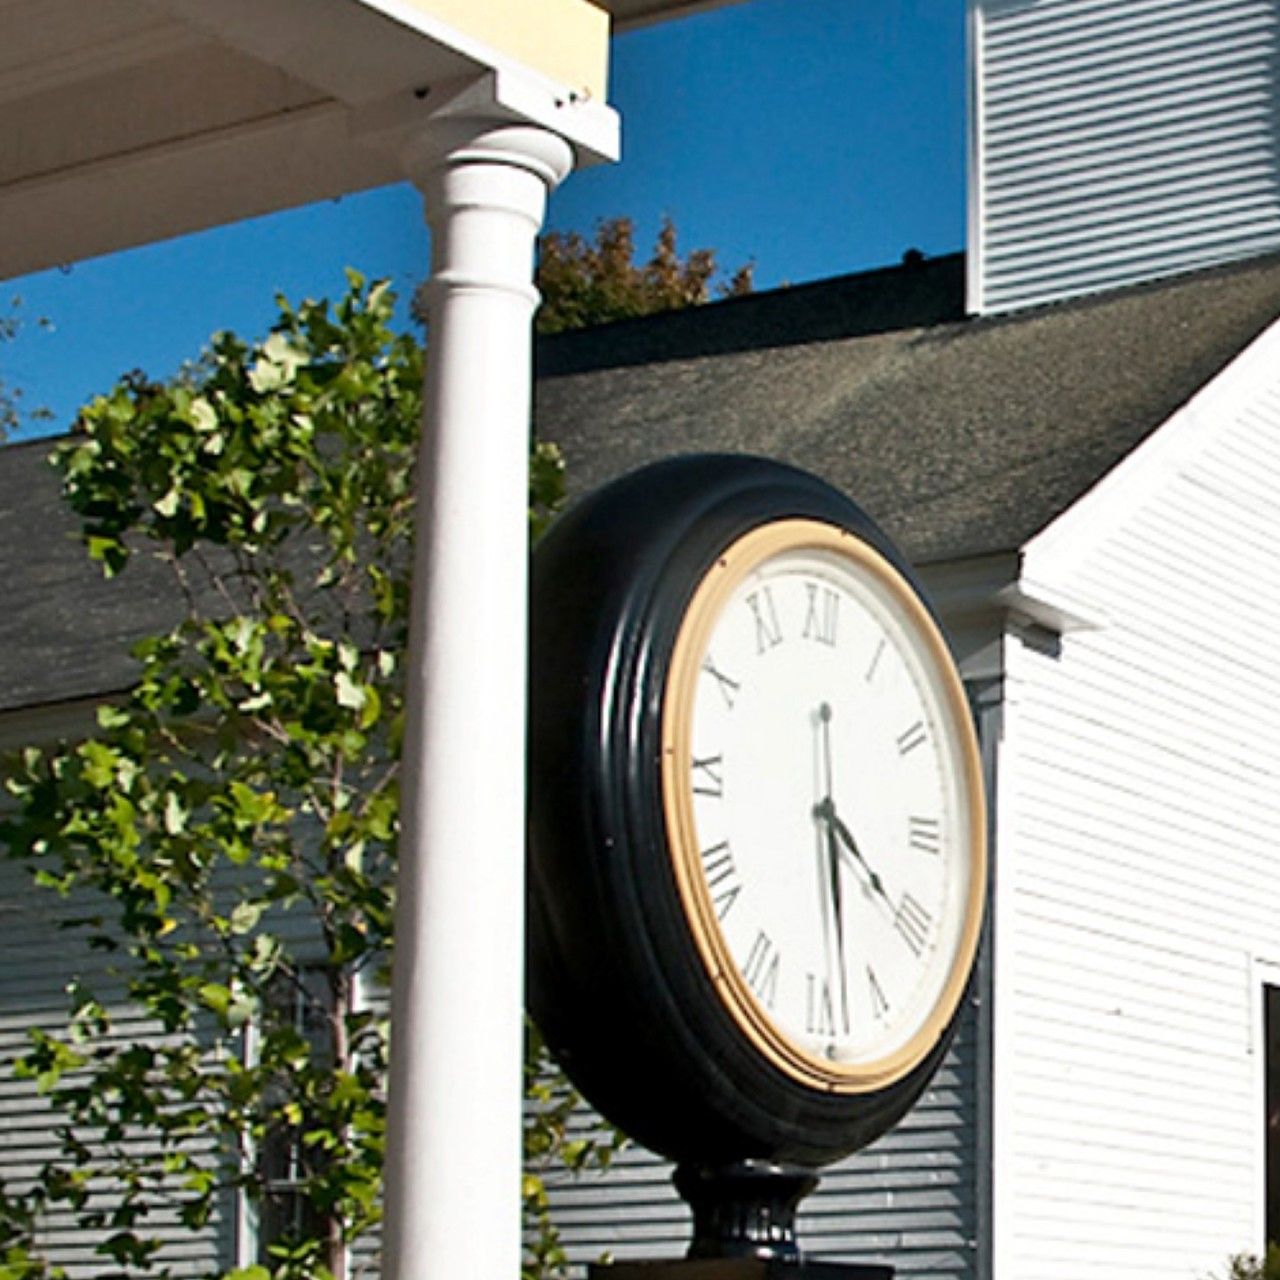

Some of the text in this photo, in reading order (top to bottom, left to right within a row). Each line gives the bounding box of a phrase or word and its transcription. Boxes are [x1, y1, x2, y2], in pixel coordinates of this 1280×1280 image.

[746, 586, 783, 654] XI
[805, 582, 840, 647] XII
[702, 654, 740, 709] X
[865, 639, 886, 681] I
[896, 721, 927, 755] II
[692, 754, 722, 797] IX
[908, 816, 940, 855] III
[701, 839, 742, 921] VIII
[742, 929, 780, 1009] VII
[866, 964, 890, 1018] V
[806, 973, 837, 1036] VI
